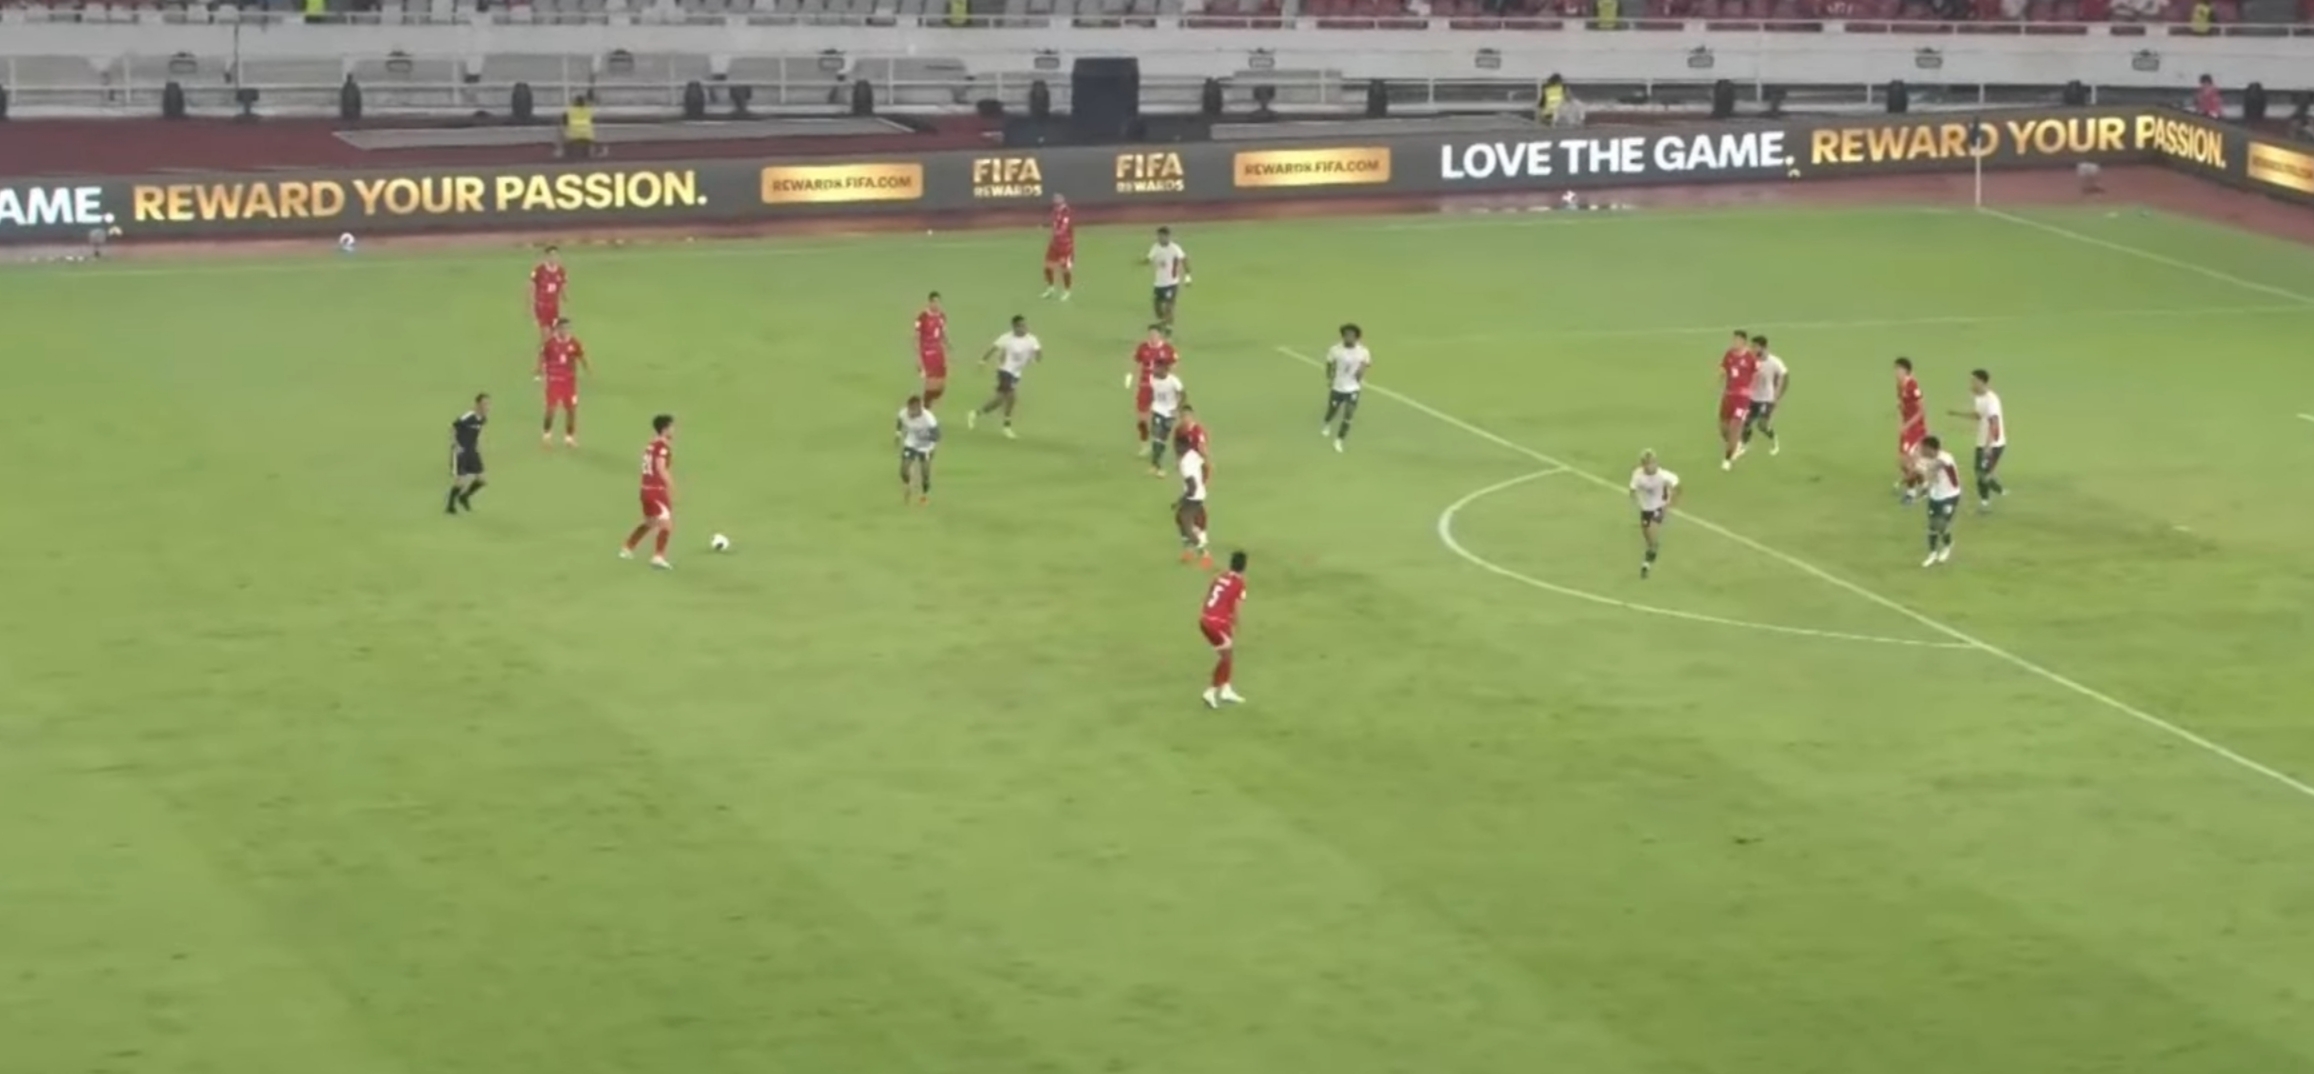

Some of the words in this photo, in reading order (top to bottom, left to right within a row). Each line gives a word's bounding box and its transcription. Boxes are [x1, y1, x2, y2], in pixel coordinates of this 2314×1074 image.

[1811, 122, 1999, 164] REWARD
[2007, 117, 2126, 154] YOUR
[2135, 115, 2227, 169] PASSION.
[1116, 152, 1184, 178] FIFA
[1440, 140, 1553, 179] LOVE
[1559, 136, 1646, 175] THE
[1654, 131, 1795, 171] GAME.
[973, 157, 1042, 183] FIFA
[1245, 159, 1380, 176] REWARDS.FIFA.COM
[772, 175, 912, 192] REWARDS.FIFA.COM
[973, 185, 1043, 197] REWARDS
[1116, 179, 1185, 193] REWARDS
[133, 181, 345, 222] REWARD
[352, 176, 486, 216] YOUR
[495, 170, 708, 211] PASSION.
[1208, 585, 1225, 607] 5
